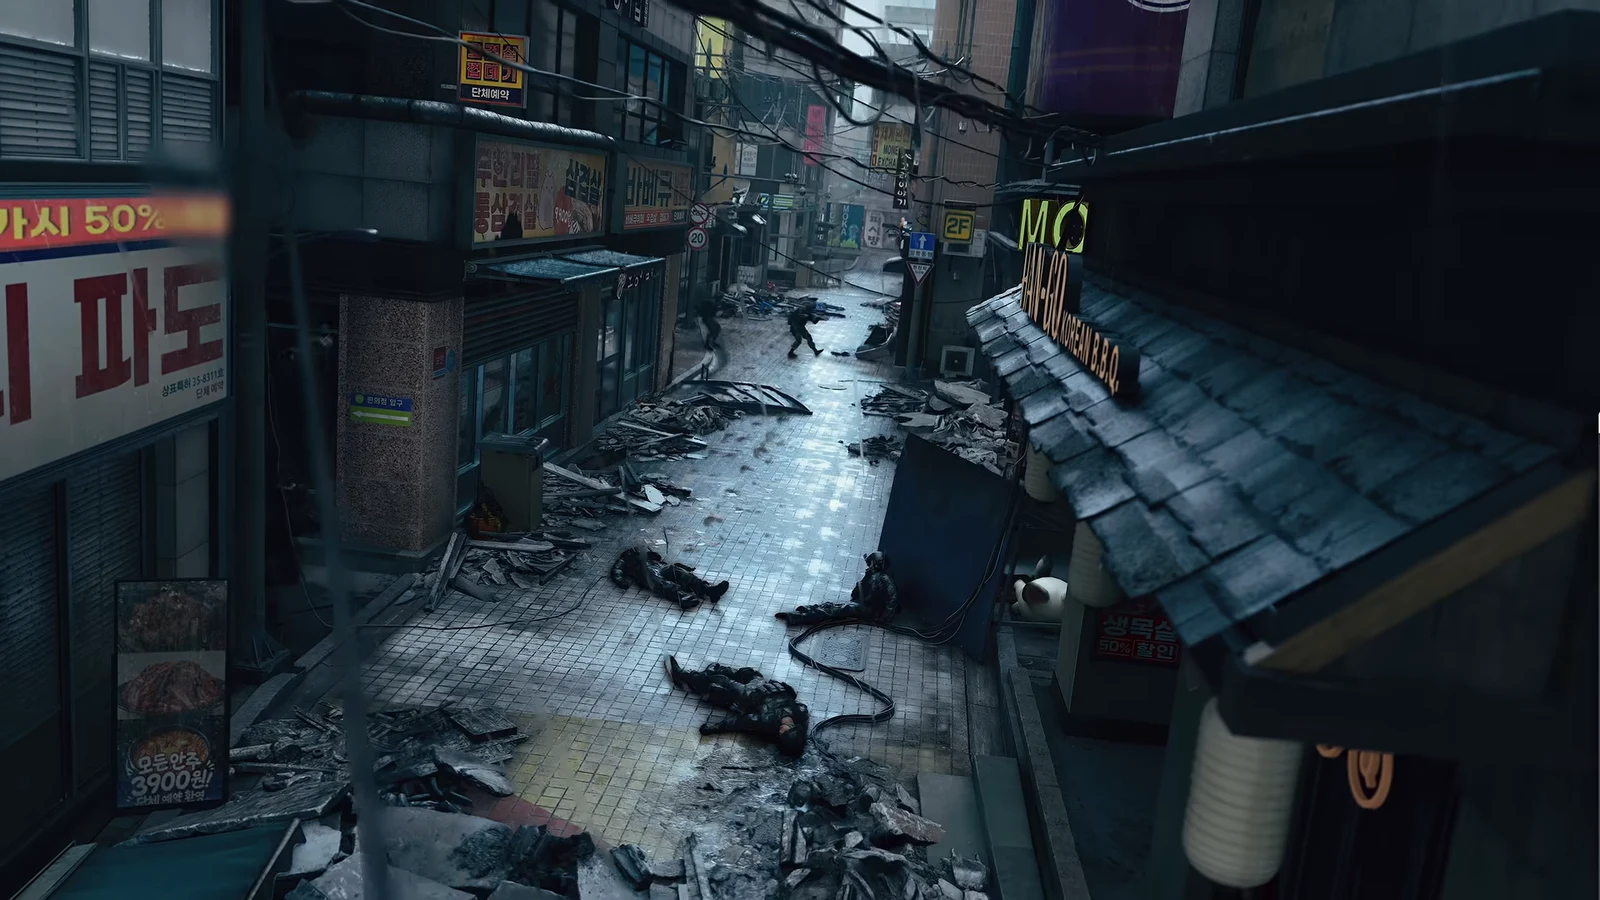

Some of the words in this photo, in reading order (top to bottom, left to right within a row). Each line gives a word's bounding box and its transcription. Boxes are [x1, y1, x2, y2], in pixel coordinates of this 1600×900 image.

[471, 87, 511, 100] 단체예약
[883, 144, 899, 155] MONE
[877, 157, 897, 168] EXCHA
[85, 204, 166, 236] 50%
[840, 204, 850, 236] MOKA
[867, 215, 882, 246] 피시방
[946, 217, 970, 234] 2F
[691, 233, 704, 243] 20
[73, 266, 224, 399] 파도
[1059, 309, 1093, 367] KOREAN
[1091, 331, 1120, 397] B.B.Q.
[162, 378, 191, 397] 상표특허
[192, 368, 224, 387] 35-8311호
[367, 396, 387, 406] 편의점
[389, 398, 403, 407] 입구
[1100, 639, 1131, 654] 50%
[1136, 642, 1174, 660] 할인
[131, 769, 214, 797] 3900원!
